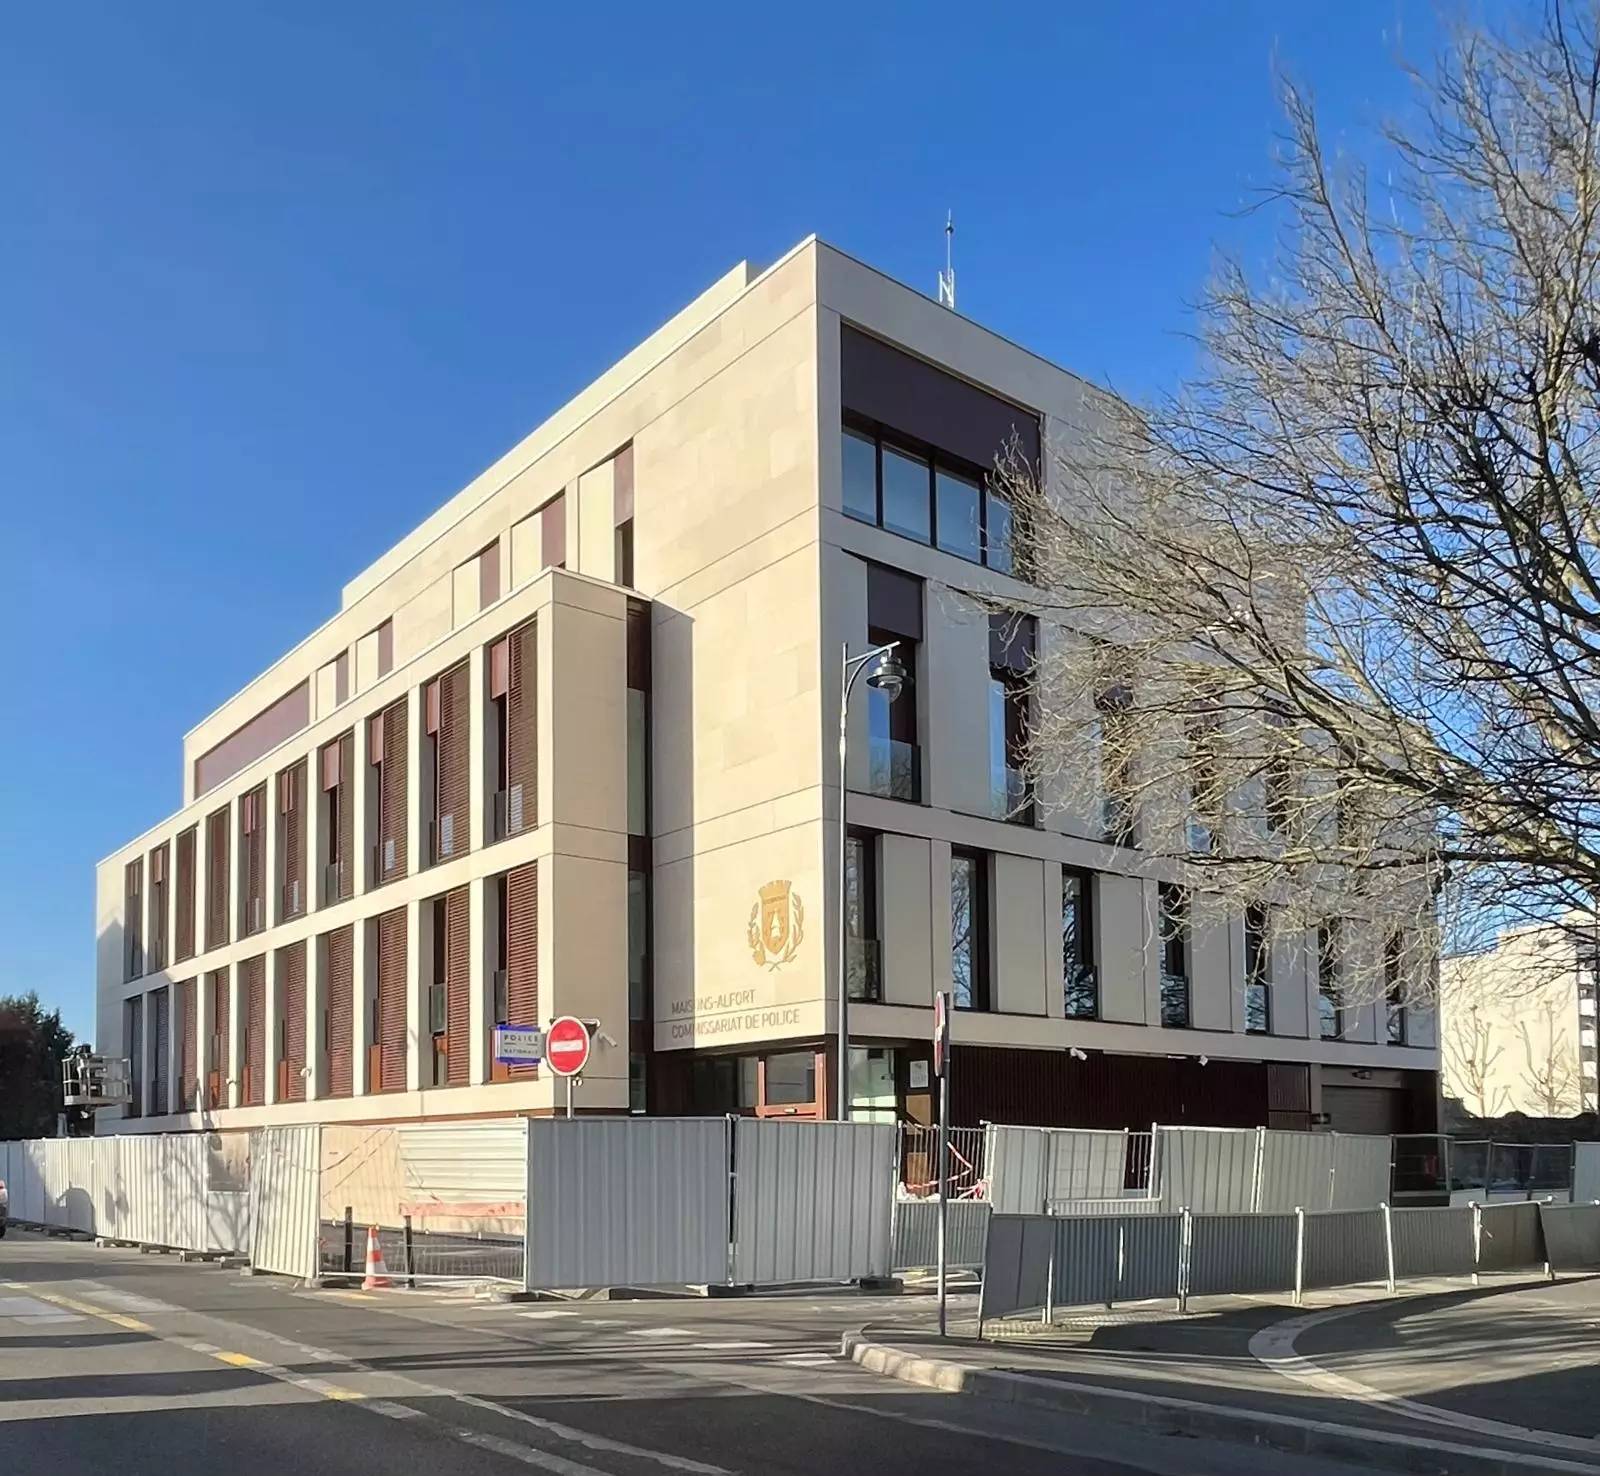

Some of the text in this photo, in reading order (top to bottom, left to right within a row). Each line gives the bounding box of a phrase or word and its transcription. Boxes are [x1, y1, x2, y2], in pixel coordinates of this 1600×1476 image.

[671, 1009, 800, 1039] COMMISSARIAT DE POLICE
[503, 1034, 538, 1042] POLICE
